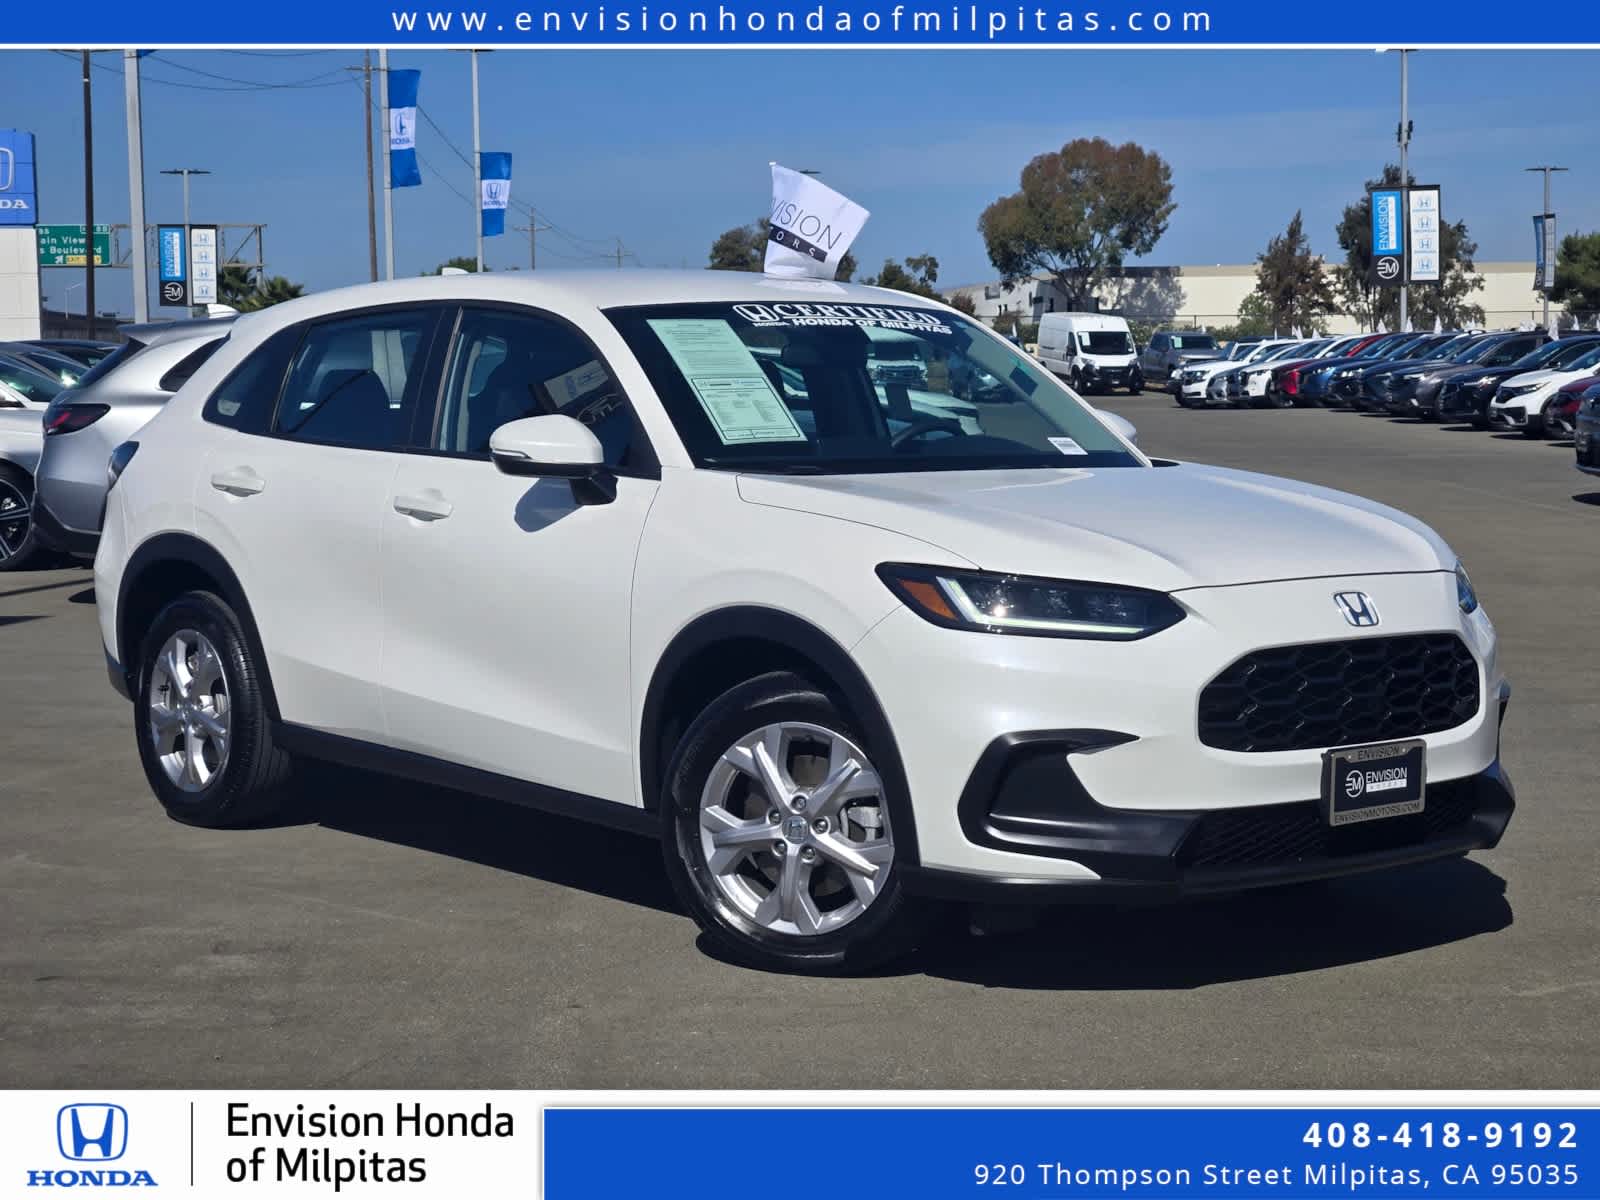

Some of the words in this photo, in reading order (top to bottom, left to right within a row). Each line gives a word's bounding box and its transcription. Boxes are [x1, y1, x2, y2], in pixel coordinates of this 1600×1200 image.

[1377, 196, 1388, 250] ENVISION
[62, 236, 87, 245] View
[769, 226, 816, 257] ORS
[50, 246, 102, 254] Boulevrd
[773, 304, 942, 325] CERTIFIED
[793, 318, 853, 327] HONDA
[880, 320, 953, 335] MILPITAS
[1358, 746, 1400, 759] ENVISION
[1365, 767, 1408, 783] ENVISION
[1335, 802, 1420, 823] ENVISIONMOTORS.COM
